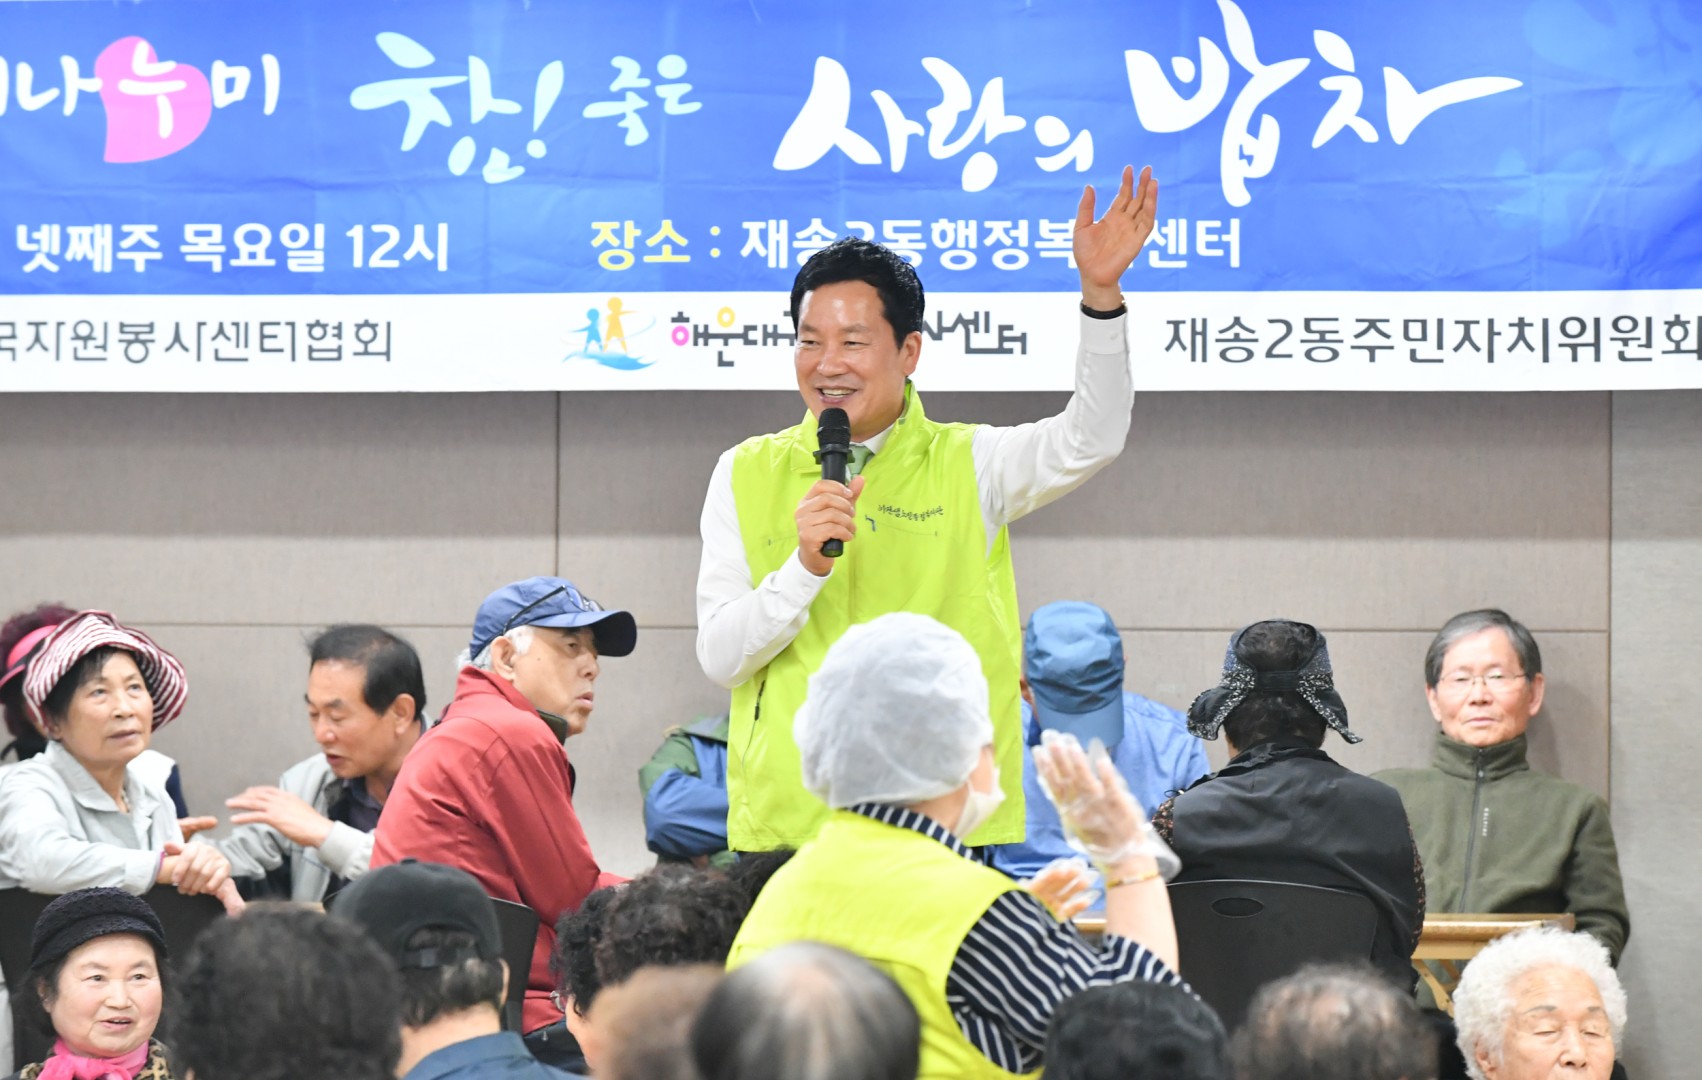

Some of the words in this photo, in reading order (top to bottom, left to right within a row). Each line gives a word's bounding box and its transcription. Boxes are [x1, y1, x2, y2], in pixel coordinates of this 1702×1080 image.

[0, 39, 281, 139] 나누미
[772, 55, 1095, 193] 사랑의
[1123, 0, 1524, 207] 밥차
[16, 223, 164, 273] 넷째주
[179, 223, 326, 273] 목요일
[346, 222, 450, 272] 12시
[590, 219, 692, 271] 장소
[739, 217, 1241, 270] 재송동행정복센터
[1164, 313, 1702, 364] 재송2동주민자치위원회
